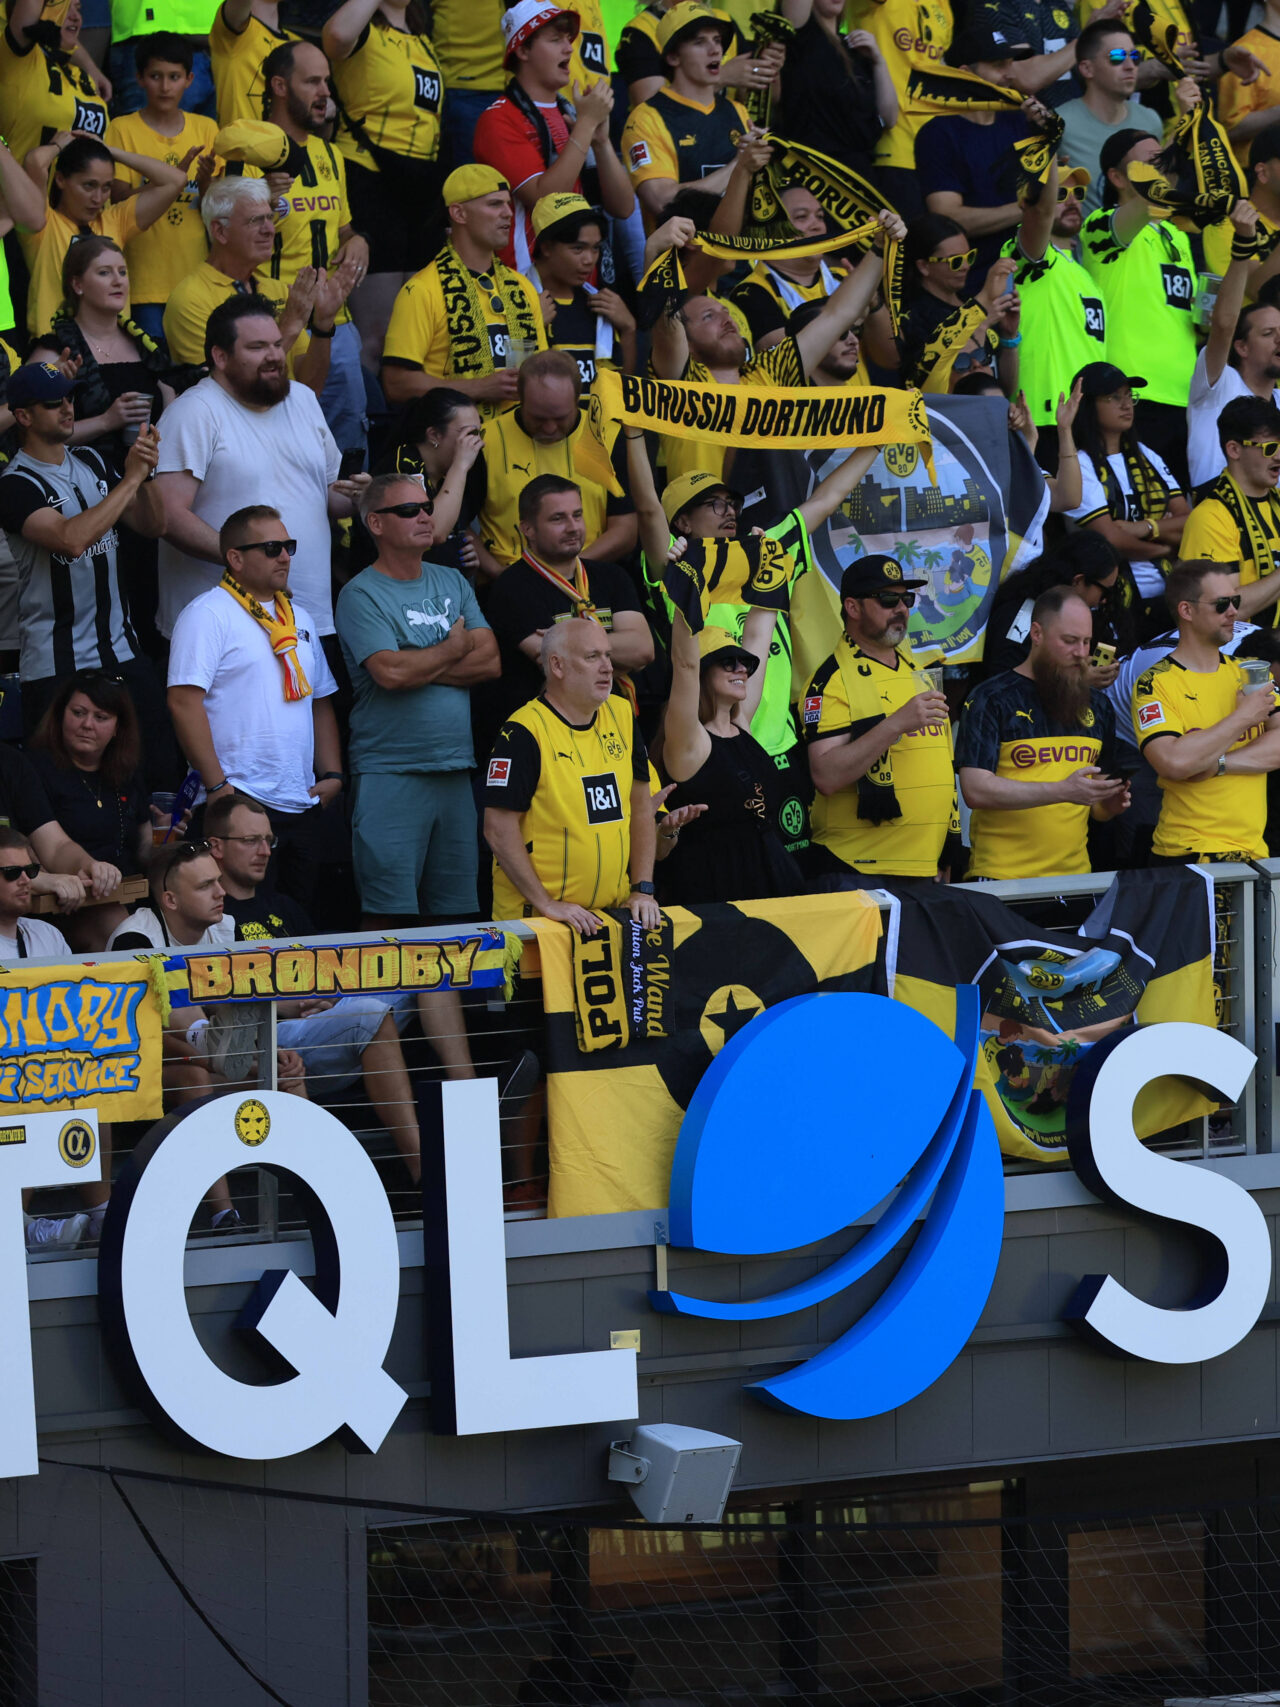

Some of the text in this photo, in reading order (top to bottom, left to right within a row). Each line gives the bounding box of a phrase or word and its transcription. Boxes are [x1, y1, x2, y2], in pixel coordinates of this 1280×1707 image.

[416, 74, 440, 101] 1&1
[77, 105, 105, 134] 1&1
[1199, 141, 1212, 167] FAN
[1210, 137, 1232, 193] CHICAGO
[1163, 273, 1191, 300] 1&1
[621, 375, 887, 437] BORUSSIA DORTMUND
[757, 540, 785, 584] BVB
[607, 741, 622, 756] BVB
[880, 772, 891, 782] 09
[587, 784, 618, 811] 1&1
[785, 802, 801, 826] BVB
[185, 938, 482, 1000] BRØNDBY
[630, 961, 644, 994] Jack
[0, 979, 144, 1054] NDBY
[633, 997, 645, 1023] Pub
